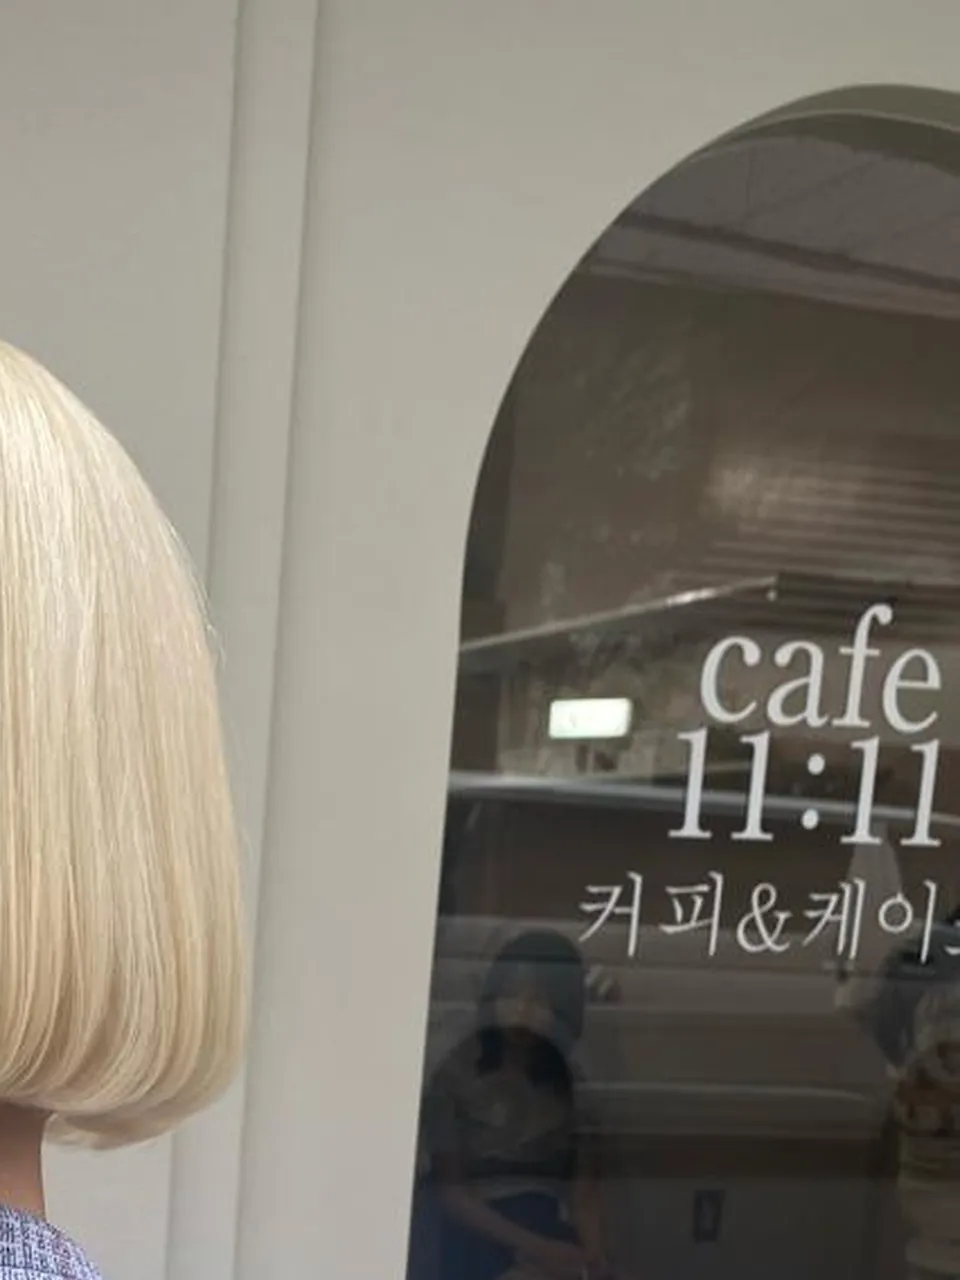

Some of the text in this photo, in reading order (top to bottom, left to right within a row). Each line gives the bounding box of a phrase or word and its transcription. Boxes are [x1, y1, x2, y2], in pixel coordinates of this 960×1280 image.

[700, 603, 941, 733] cafe
[668, 727, 942, 847] 11:11
[579, 871, 960, 963] 커피&케이
